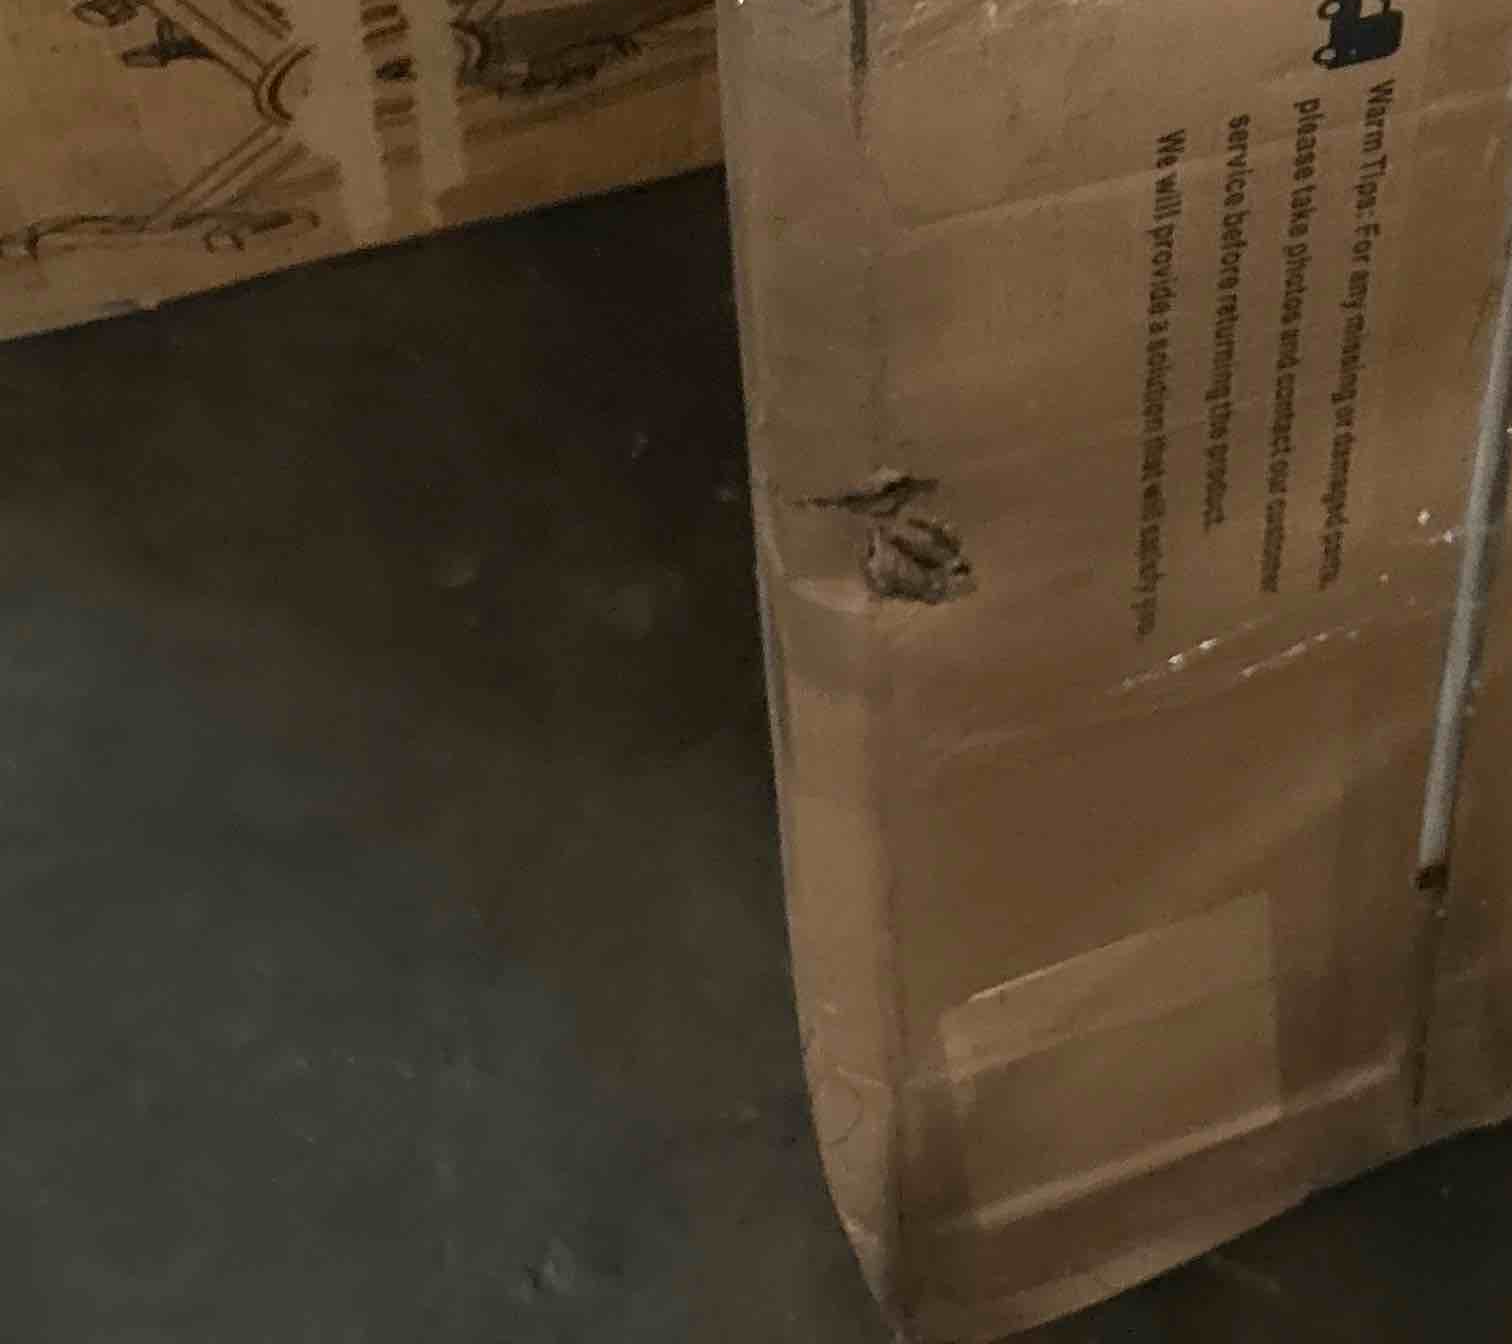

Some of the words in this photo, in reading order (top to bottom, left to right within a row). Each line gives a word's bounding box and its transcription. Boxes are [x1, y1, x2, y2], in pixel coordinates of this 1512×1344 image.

[1155, 130, 1185, 169] We
[1293, 98, 1324, 180] please
[1364, 80, 1396, 152] Warm
[1224, 114, 1254, 207] service
[1355, 154, 1387, 218] Tips:
[1153, 172, 1183, 224] will
[1288, 185, 1317, 237] take
[1145, 224, 1176, 315] provide
[1218, 211, 1250, 289] before
[1352, 223, 1380, 262] For
[1281, 244, 1311, 324] photos
[1342, 271, 1371, 309] any
[1149, 321, 1167, 334] a
[1205, 294, 1239, 401] returning
[1276, 329, 1306, 369] and
[1143, 339, 1169, 432] solution
[1270, 373, 1296, 457] contact
[1208, 402, 1234, 440] the
